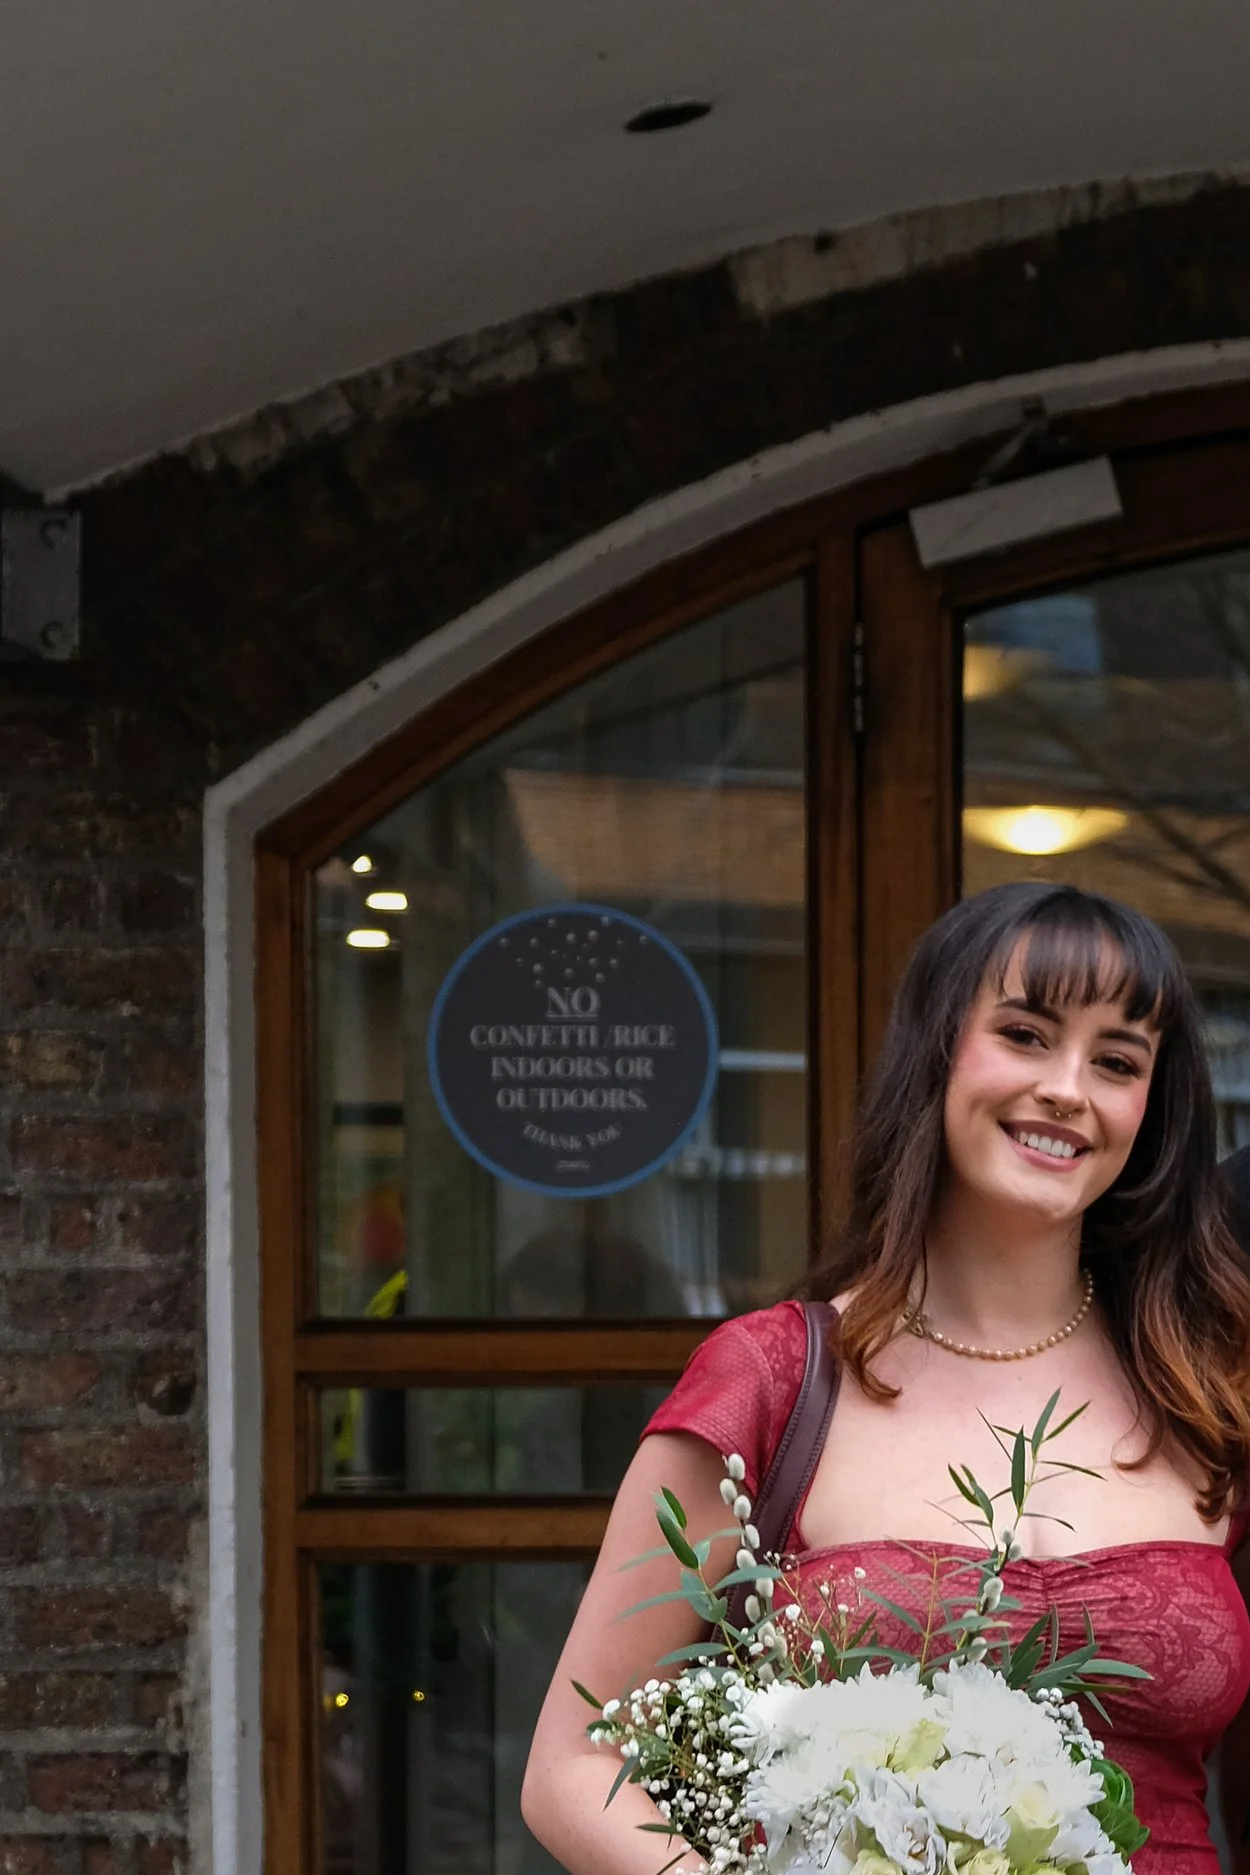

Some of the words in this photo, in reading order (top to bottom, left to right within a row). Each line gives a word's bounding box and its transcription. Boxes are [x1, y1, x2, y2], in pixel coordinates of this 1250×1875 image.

[546, 986, 600, 1018] NO
[469, 1025, 599, 1047] CONFETTI
[490, 1056, 610, 1079] INDOORS
[615, 1056, 655, 1079] OR
[496, 1088, 648, 1111] OUTDOORS.
